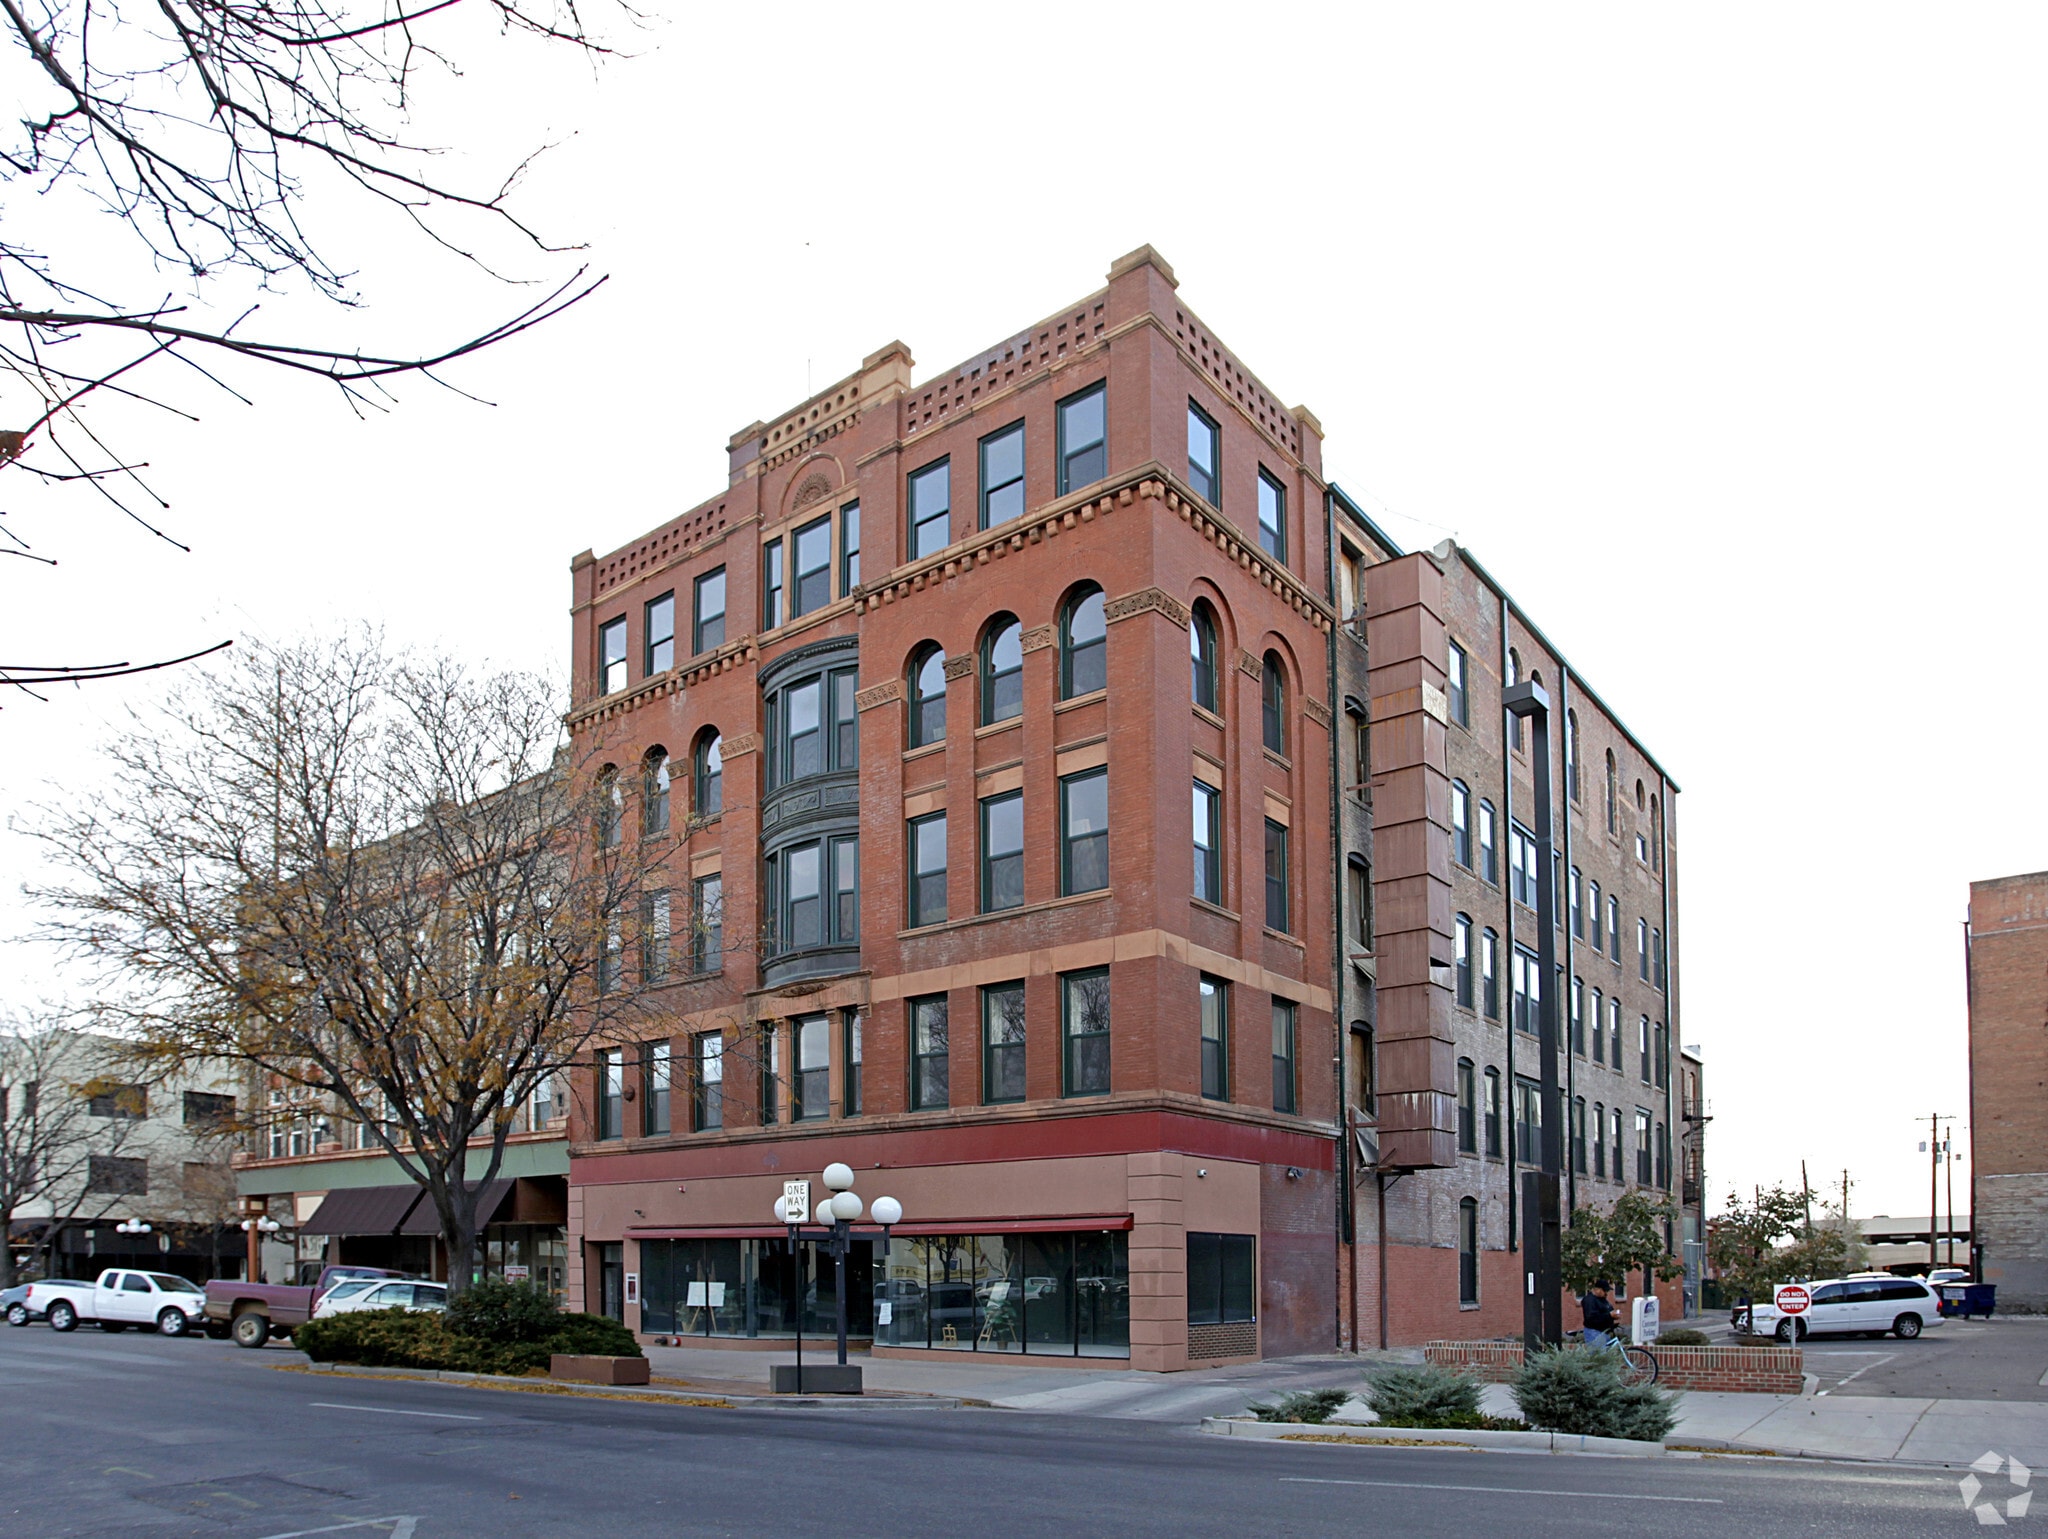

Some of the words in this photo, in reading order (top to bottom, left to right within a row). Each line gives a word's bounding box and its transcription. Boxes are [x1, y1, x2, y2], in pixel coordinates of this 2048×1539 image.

[807, 983, 858, 1008] BUILDING
[787, 1184, 805, 1195] ONE
[787, 1196, 805, 1206] WAY
